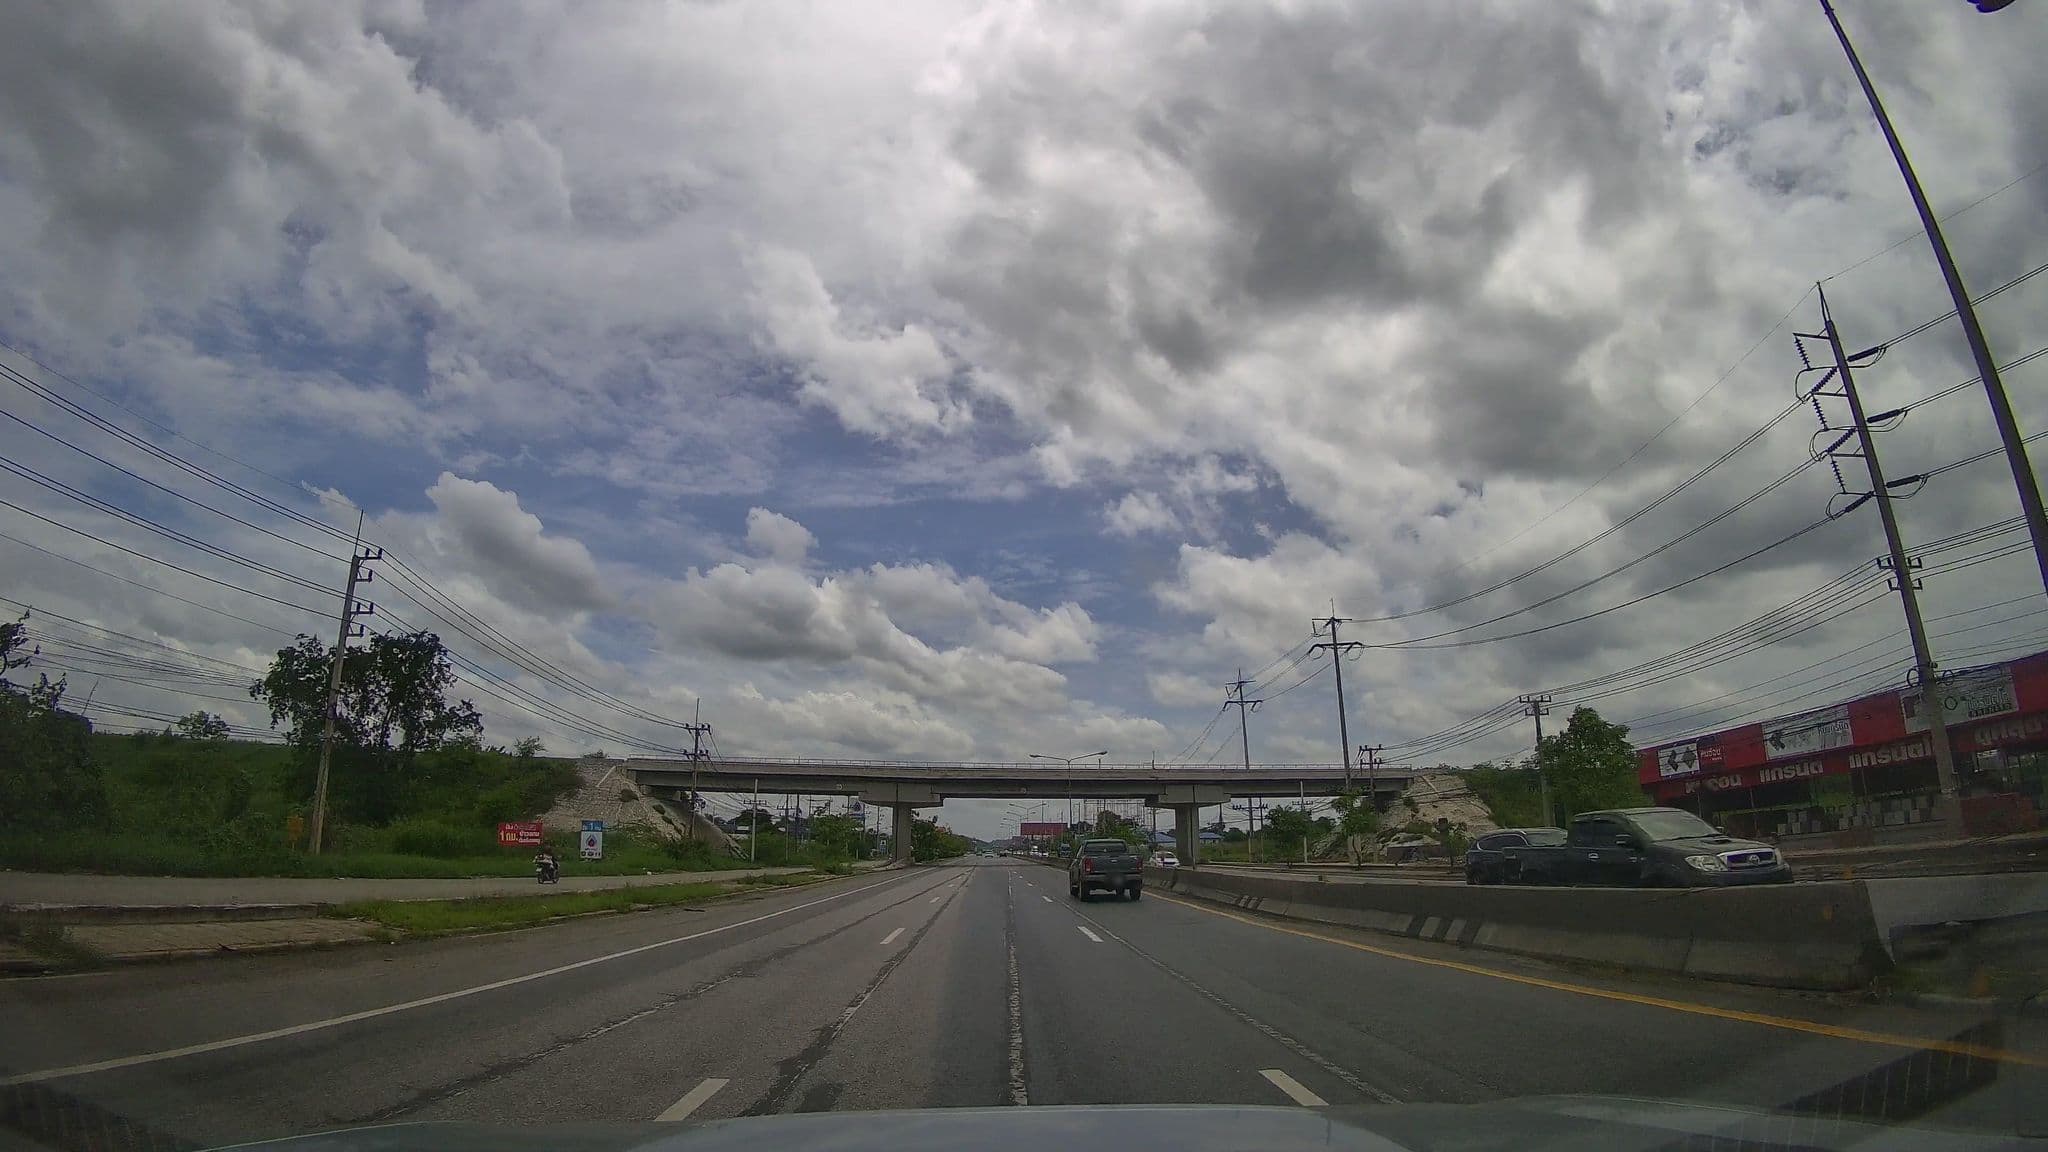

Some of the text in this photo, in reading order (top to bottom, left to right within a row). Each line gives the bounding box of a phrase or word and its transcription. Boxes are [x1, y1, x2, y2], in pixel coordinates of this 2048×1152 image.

[1759, 759, 1823, 783] แกรนิต
[500, 830, 505, 841] 1
